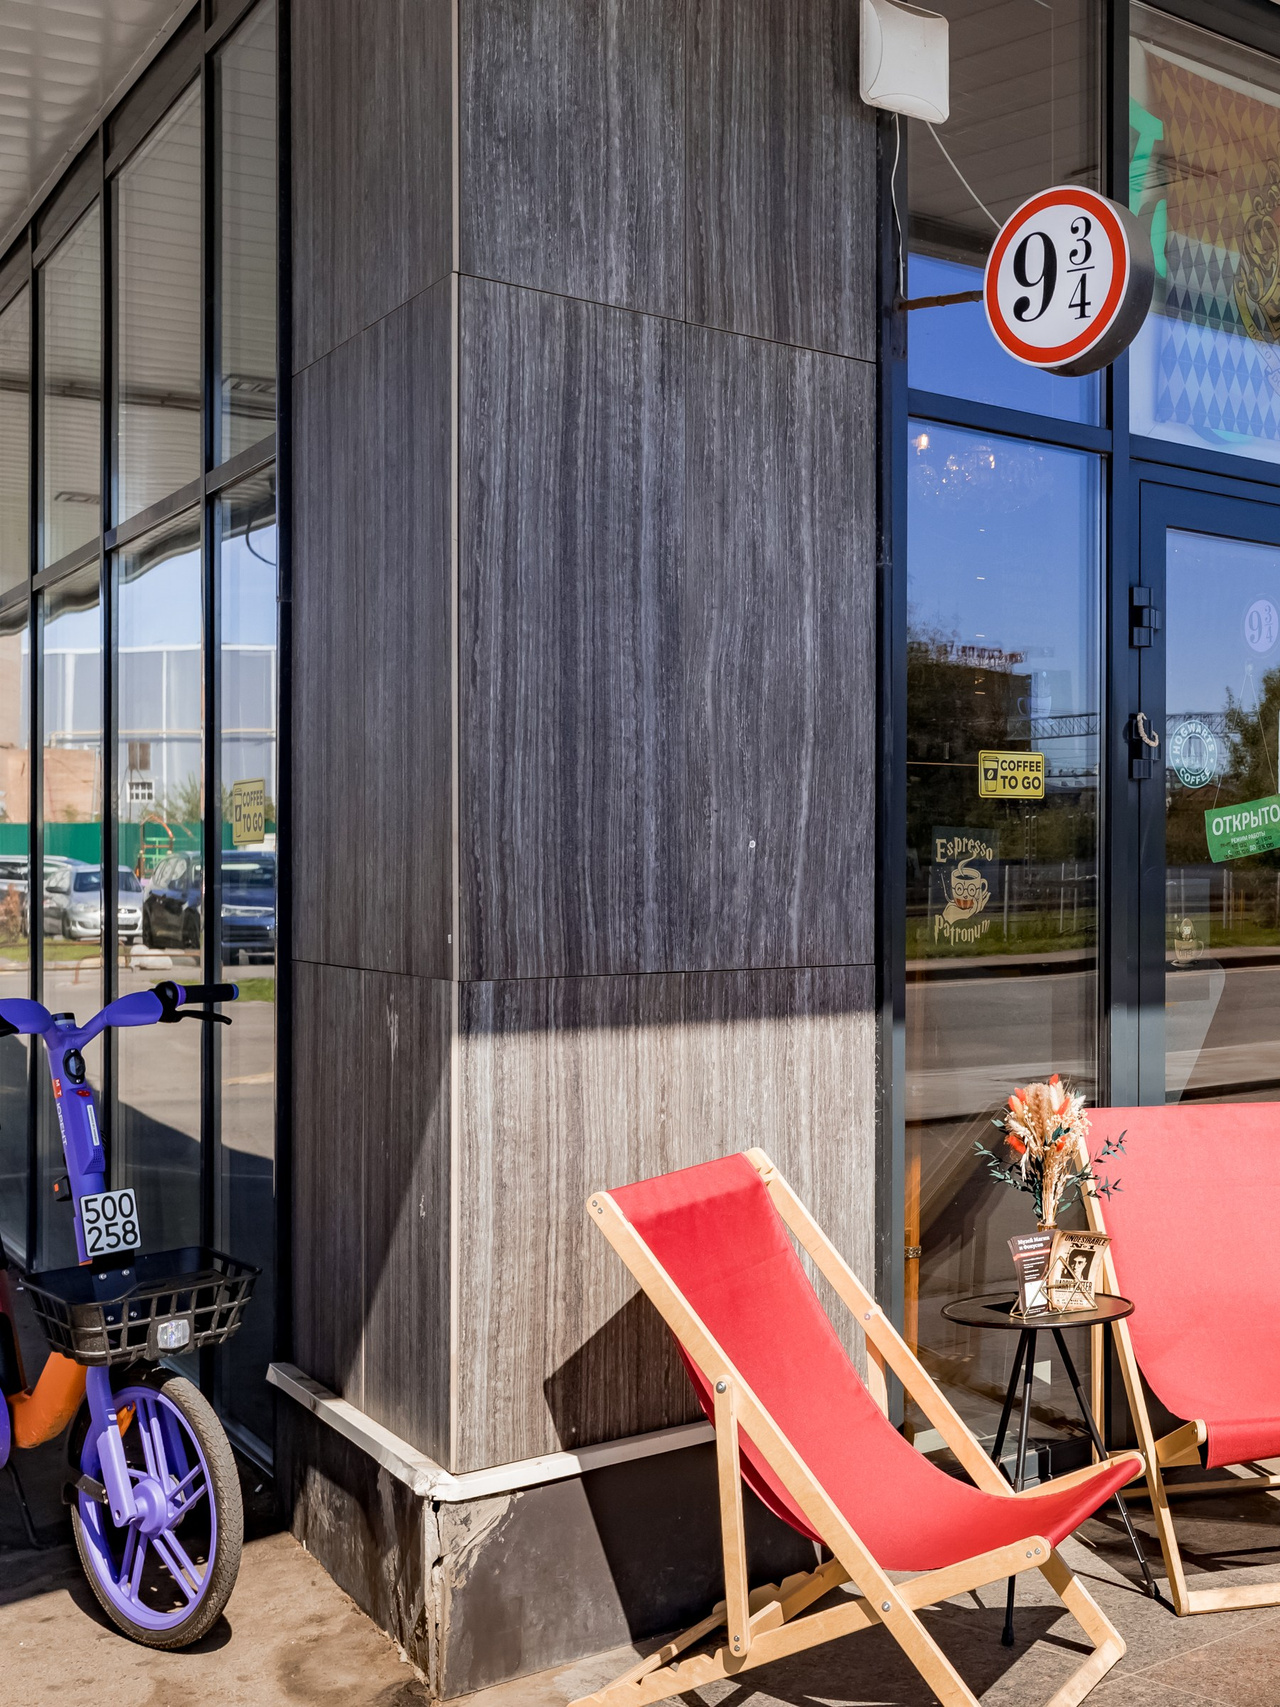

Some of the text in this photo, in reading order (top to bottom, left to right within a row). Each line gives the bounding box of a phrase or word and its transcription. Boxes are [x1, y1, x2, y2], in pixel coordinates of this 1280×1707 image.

[1172, 723, 1215, 755] HOGWARTS
[1000, 759, 1042, 772] COFFEE
[1179, 767, 1211, 785] COFFEE
[1000, 775, 1042, 790] TO GO
[242, 789, 263, 807] COFFEE
[243, 811, 263, 833] TO GO
[1212, 804, 1280, 836] ОТКРЫТО
[935, 836, 993, 863] Espresso
[934, 914, 991, 947] Patronum
[56, 1102, 68, 1146] ЮРЕНТ
[84, 1192, 134, 1225] 500
[87, 1219, 139, 1253] 258
[1017, 1237, 1034, 1246] Музей
[1024, 1242, 1044, 1251] Фокусов
[1064, 1234, 1107, 1247] UNDESIRABLE
